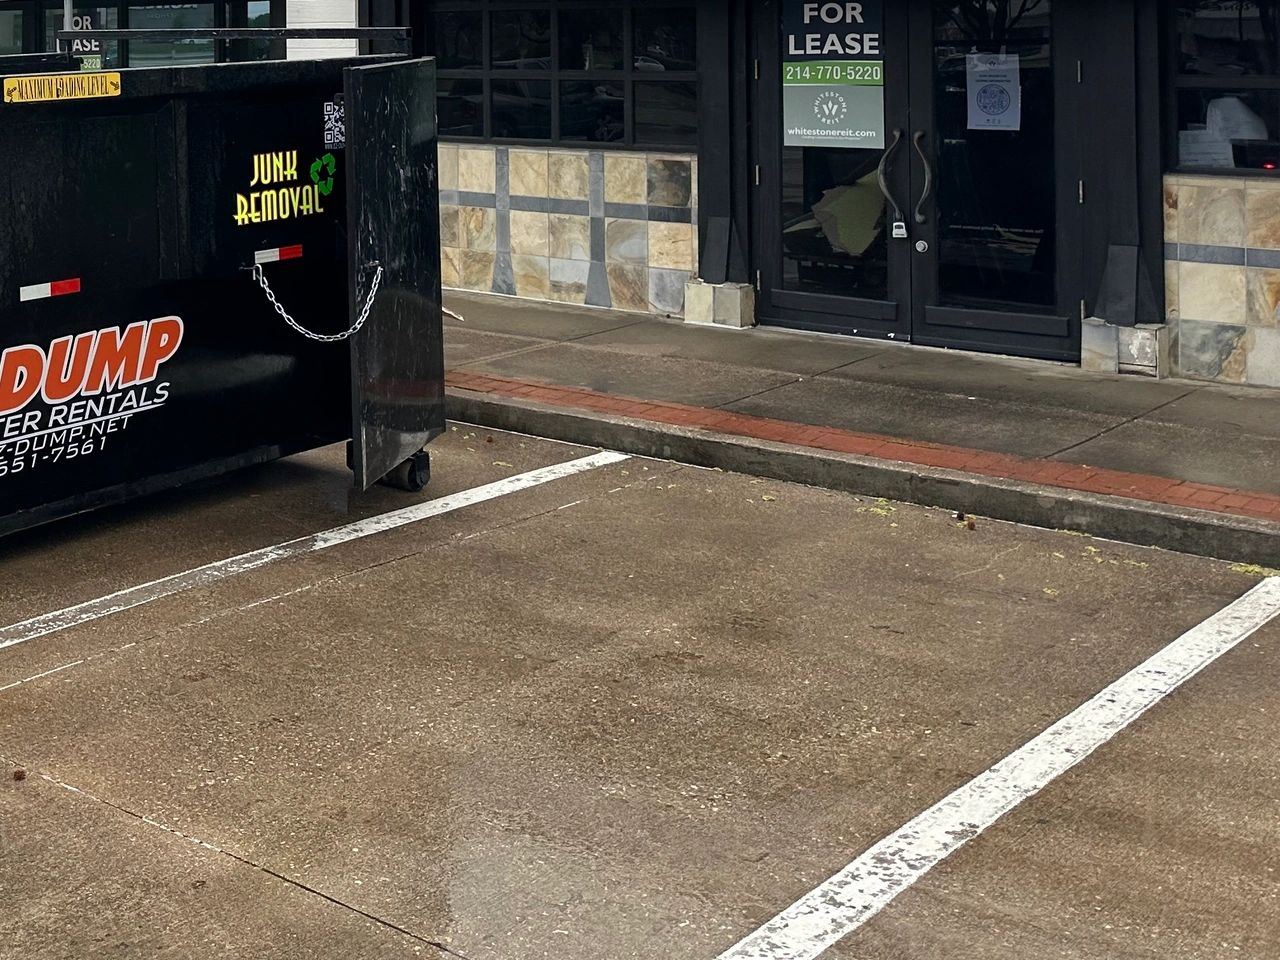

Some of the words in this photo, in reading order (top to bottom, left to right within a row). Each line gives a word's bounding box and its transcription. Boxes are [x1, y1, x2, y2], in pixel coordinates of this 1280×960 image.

[71, 15, 93, 31] OR
[803, 2, 864, 24] FOR
[788, 33, 880, 55] LEASE
[786, 65, 881, 80] 214-770-5220
[17, 78, 54, 100] MAXIMUM
[87, 75, 109, 96] LEVEL
[787, 127, 876, 137] whitestonereit.com
[250, 150, 297, 187] JUNK
[232, 184, 324, 226] REMOVAL
[48, 382, 171, 424] RENTALS
